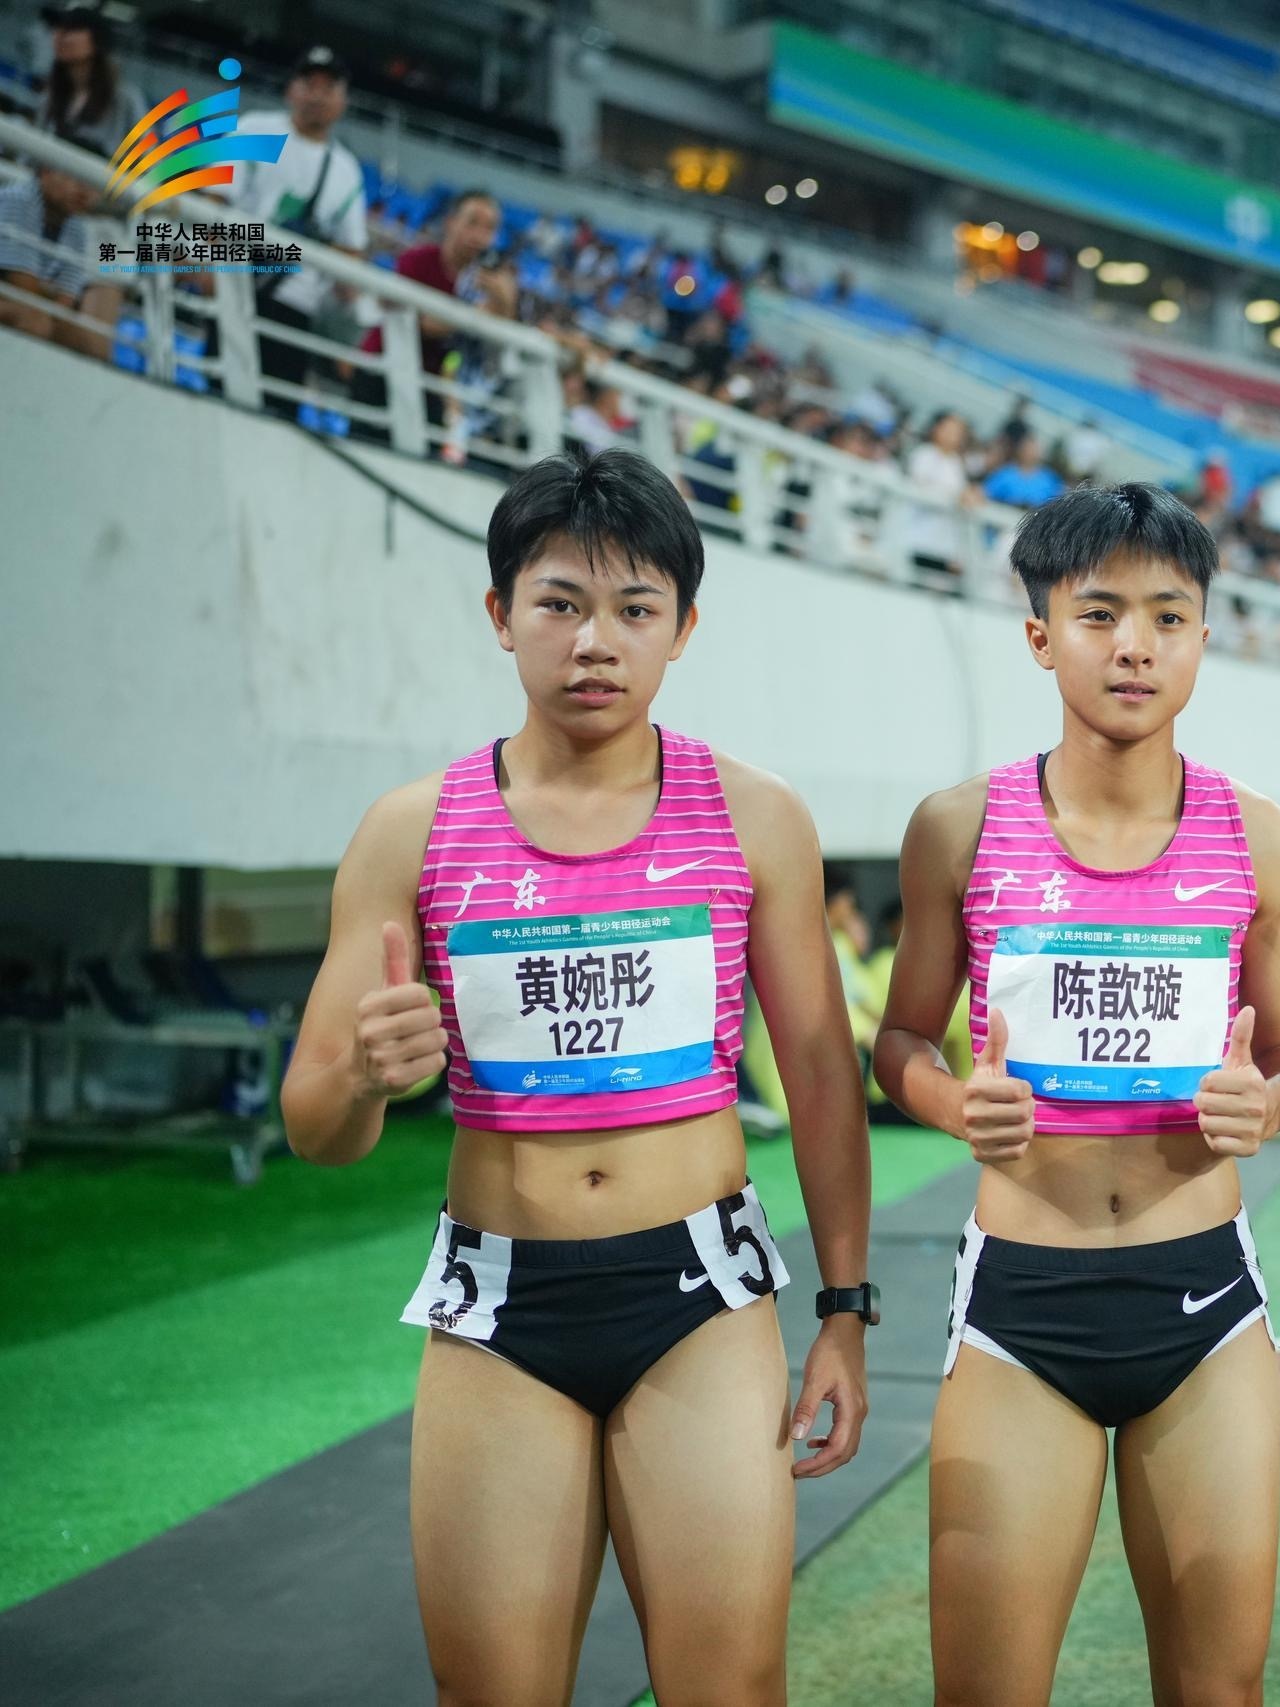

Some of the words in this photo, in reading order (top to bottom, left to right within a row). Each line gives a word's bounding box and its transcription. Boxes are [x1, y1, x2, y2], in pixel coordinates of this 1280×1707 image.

[454, 868, 545, 918] 广东
[985, 870, 1071, 913] 广东
[492, 916, 671, 939] 中华人民共和国第一届青少年田径运动会
[1037, 931, 1202, 945] 中华人民共和国第一届青少年田径运动会
[515, 949, 656, 1017] 黄婉彤
[1052, 960, 1182, 1021] 陈歆璇
[549, 1017, 624, 1056] 1227
[1078, 1027, 1151, 1063] 1222
[715, 1194, 774, 1296] 5
[429, 1223, 481, 1331] 5
